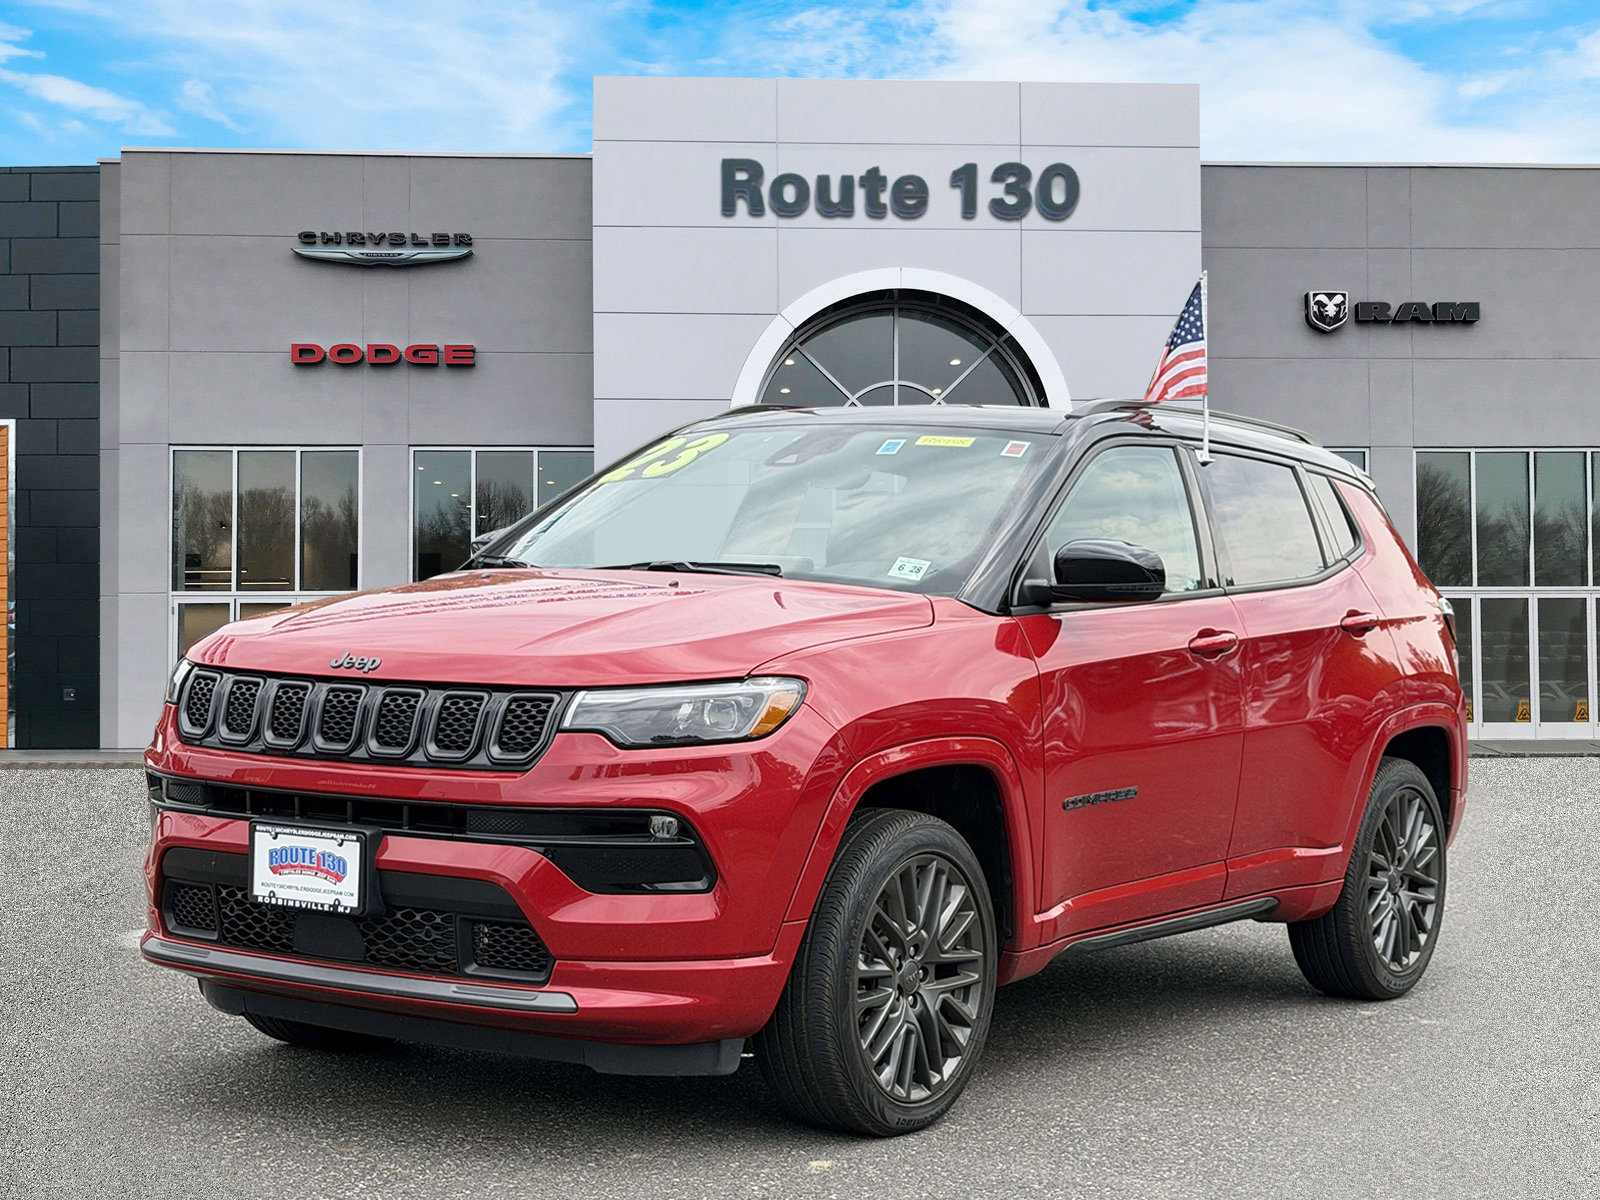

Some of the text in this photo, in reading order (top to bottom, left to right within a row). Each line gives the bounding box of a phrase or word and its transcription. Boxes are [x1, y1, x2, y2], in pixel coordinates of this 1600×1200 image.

[721, 158, 1080, 221] Route 130
[298, 231, 473, 246] CHRYSLER
[1355, 302, 1480, 324] RAM
[291, 343, 476, 365] DODGE
[598, 432, 730, 484] 23
[330, 651, 382, 674] Jeep
[268, 845, 348, 878] ROUTE 130
[337, 905, 351, 914] NJ
